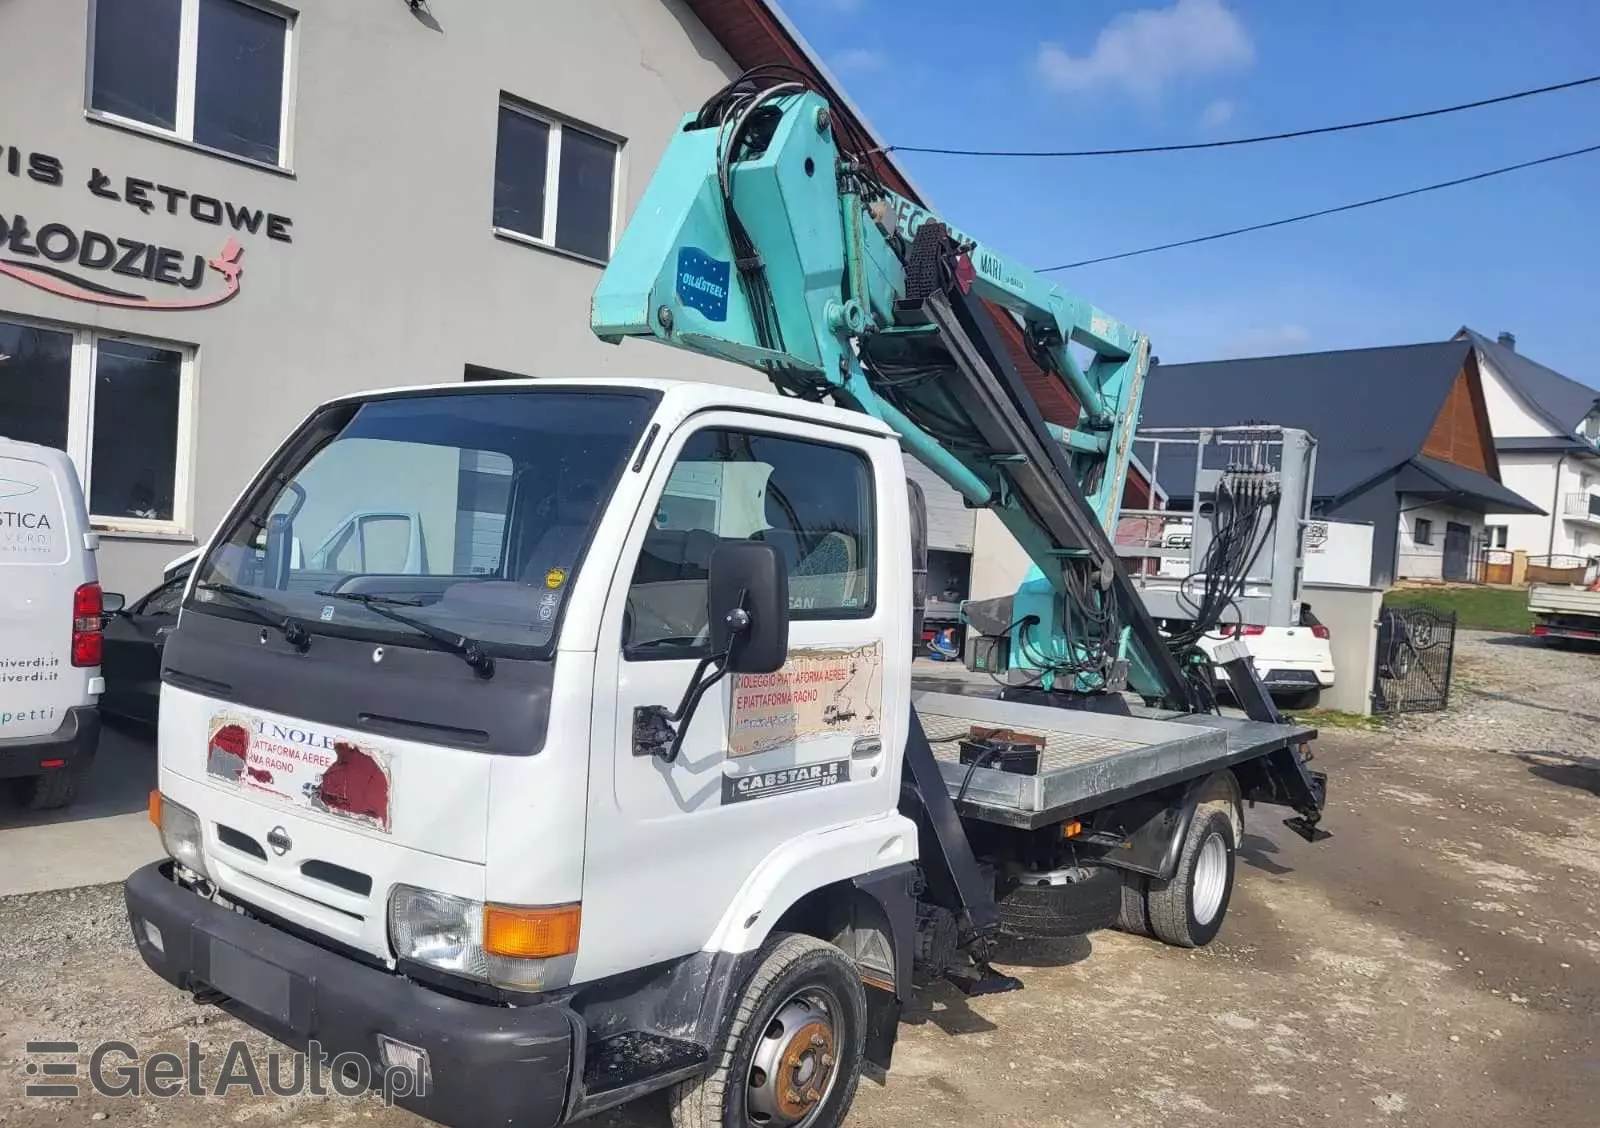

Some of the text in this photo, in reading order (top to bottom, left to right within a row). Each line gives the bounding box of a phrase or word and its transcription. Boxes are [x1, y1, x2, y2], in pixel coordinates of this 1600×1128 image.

[0, 144, 293, 243] IS ŁĘTOWE
[0, 511, 51, 529] TICA
